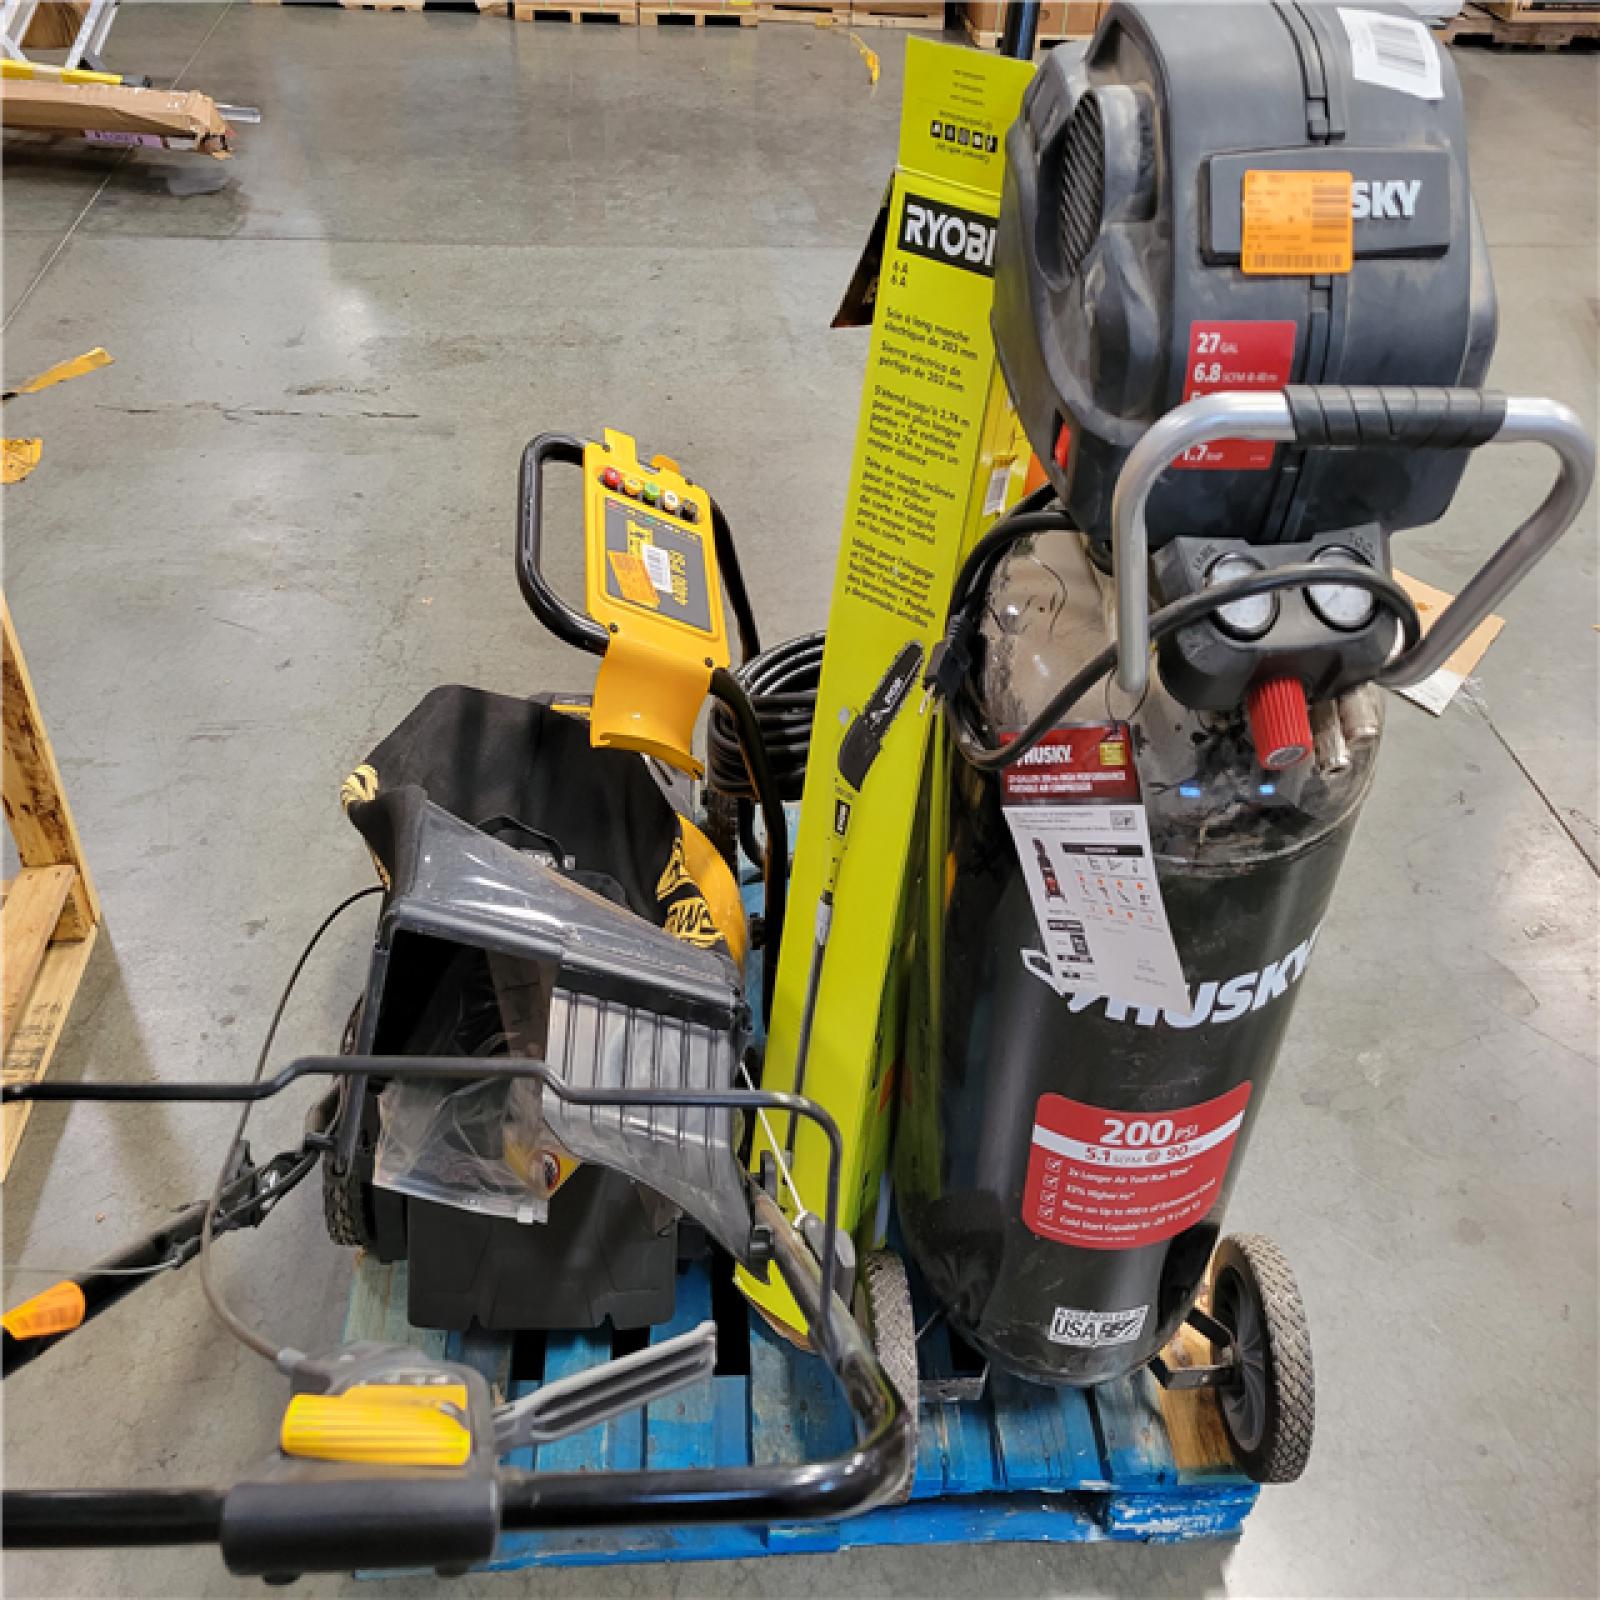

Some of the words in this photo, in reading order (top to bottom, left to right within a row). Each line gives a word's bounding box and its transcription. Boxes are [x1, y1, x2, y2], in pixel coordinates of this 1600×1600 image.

[1352, 180, 1422, 218] SKY
[905, 203, 996, 266] RYOBI
[1197, 332, 1220, 353] 27
[1194, 362, 1222, 383] 6.8
[1100, 1119, 1174, 1146] 200
[1174, 1124, 1199, 1141] PSI
[1085, 1146, 1111, 1163] 5.1
[1055, 1319, 1096, 1339] USA
